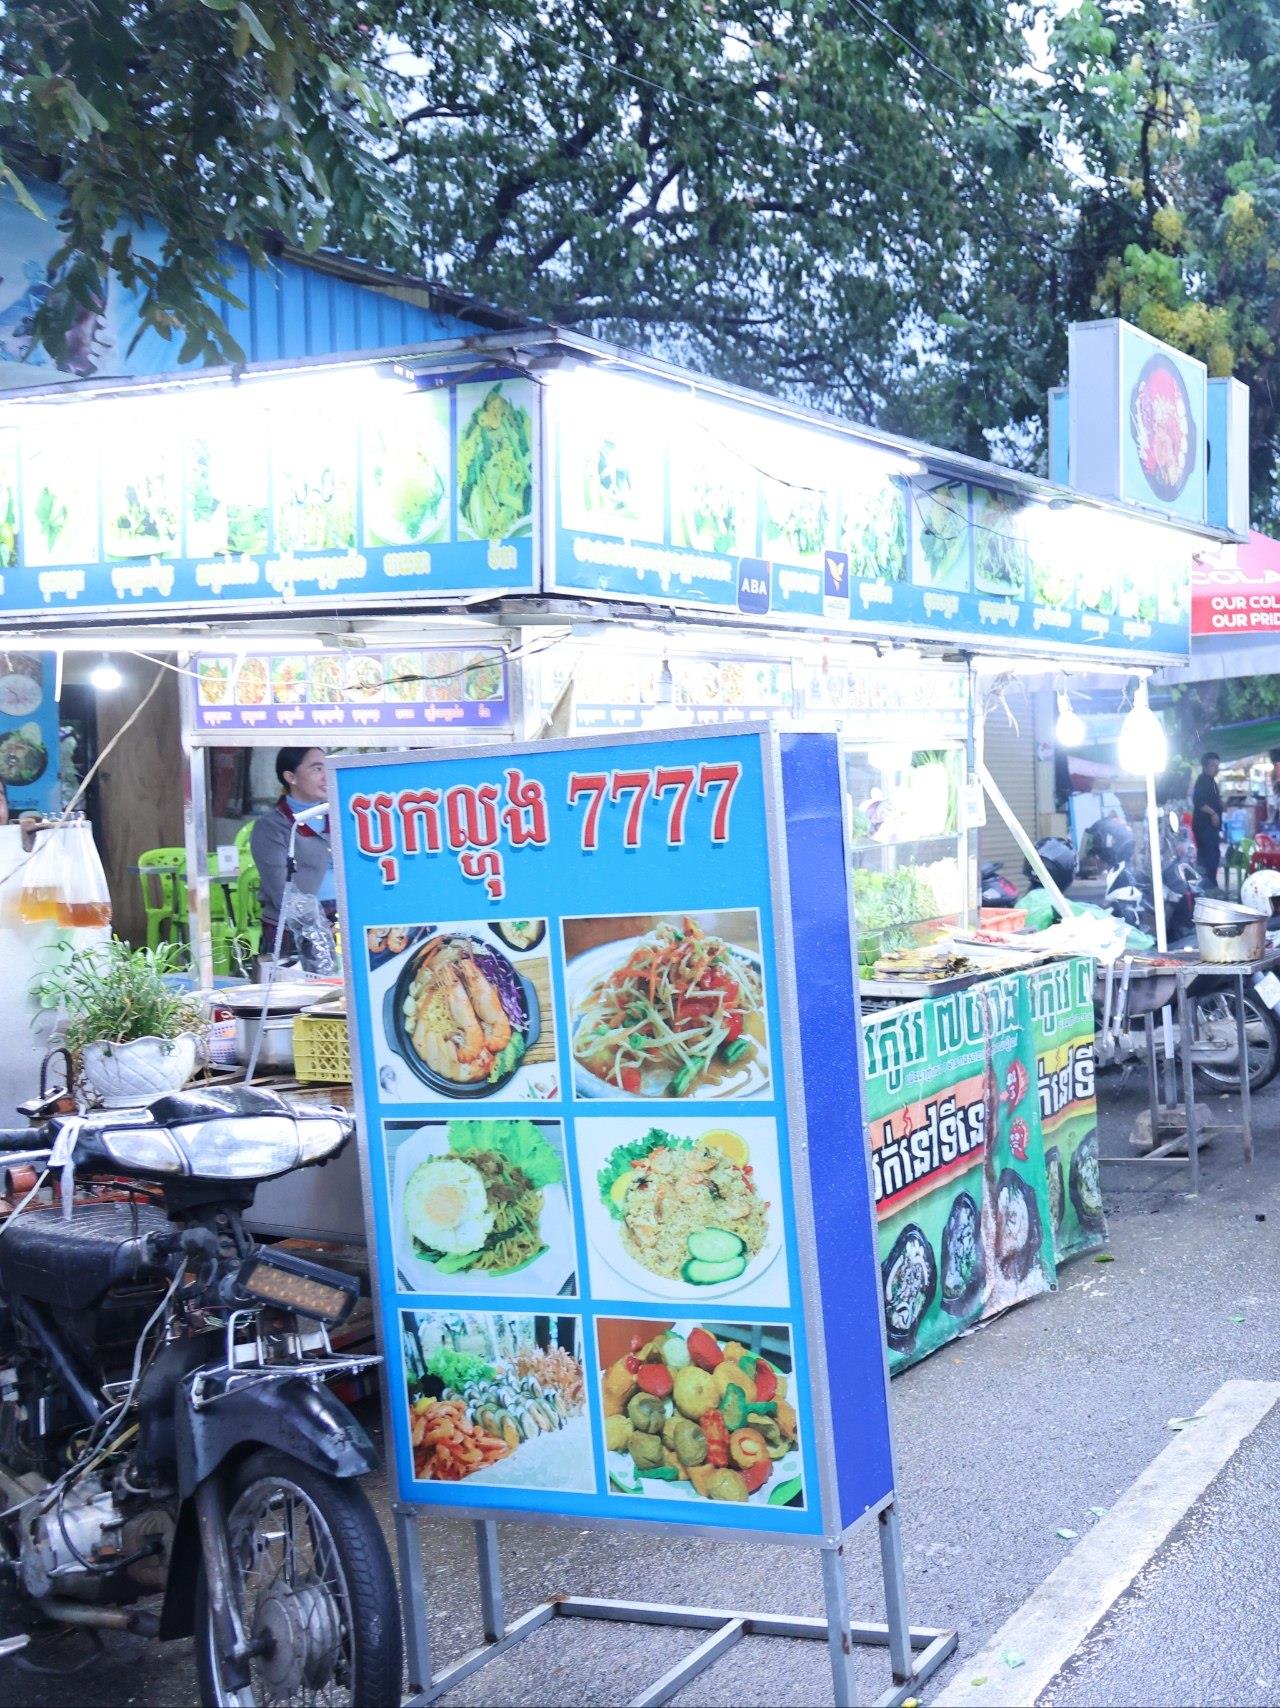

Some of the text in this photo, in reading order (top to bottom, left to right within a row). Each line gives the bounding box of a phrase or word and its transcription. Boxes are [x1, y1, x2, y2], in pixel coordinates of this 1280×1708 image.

[741, 578, 768, 596] ABA
[1211, 596, 1247, 611] OUR
[1211, 613, 1249, 628] OUR
[349, 762, 743, 902] បុកល្ហុង 7777
